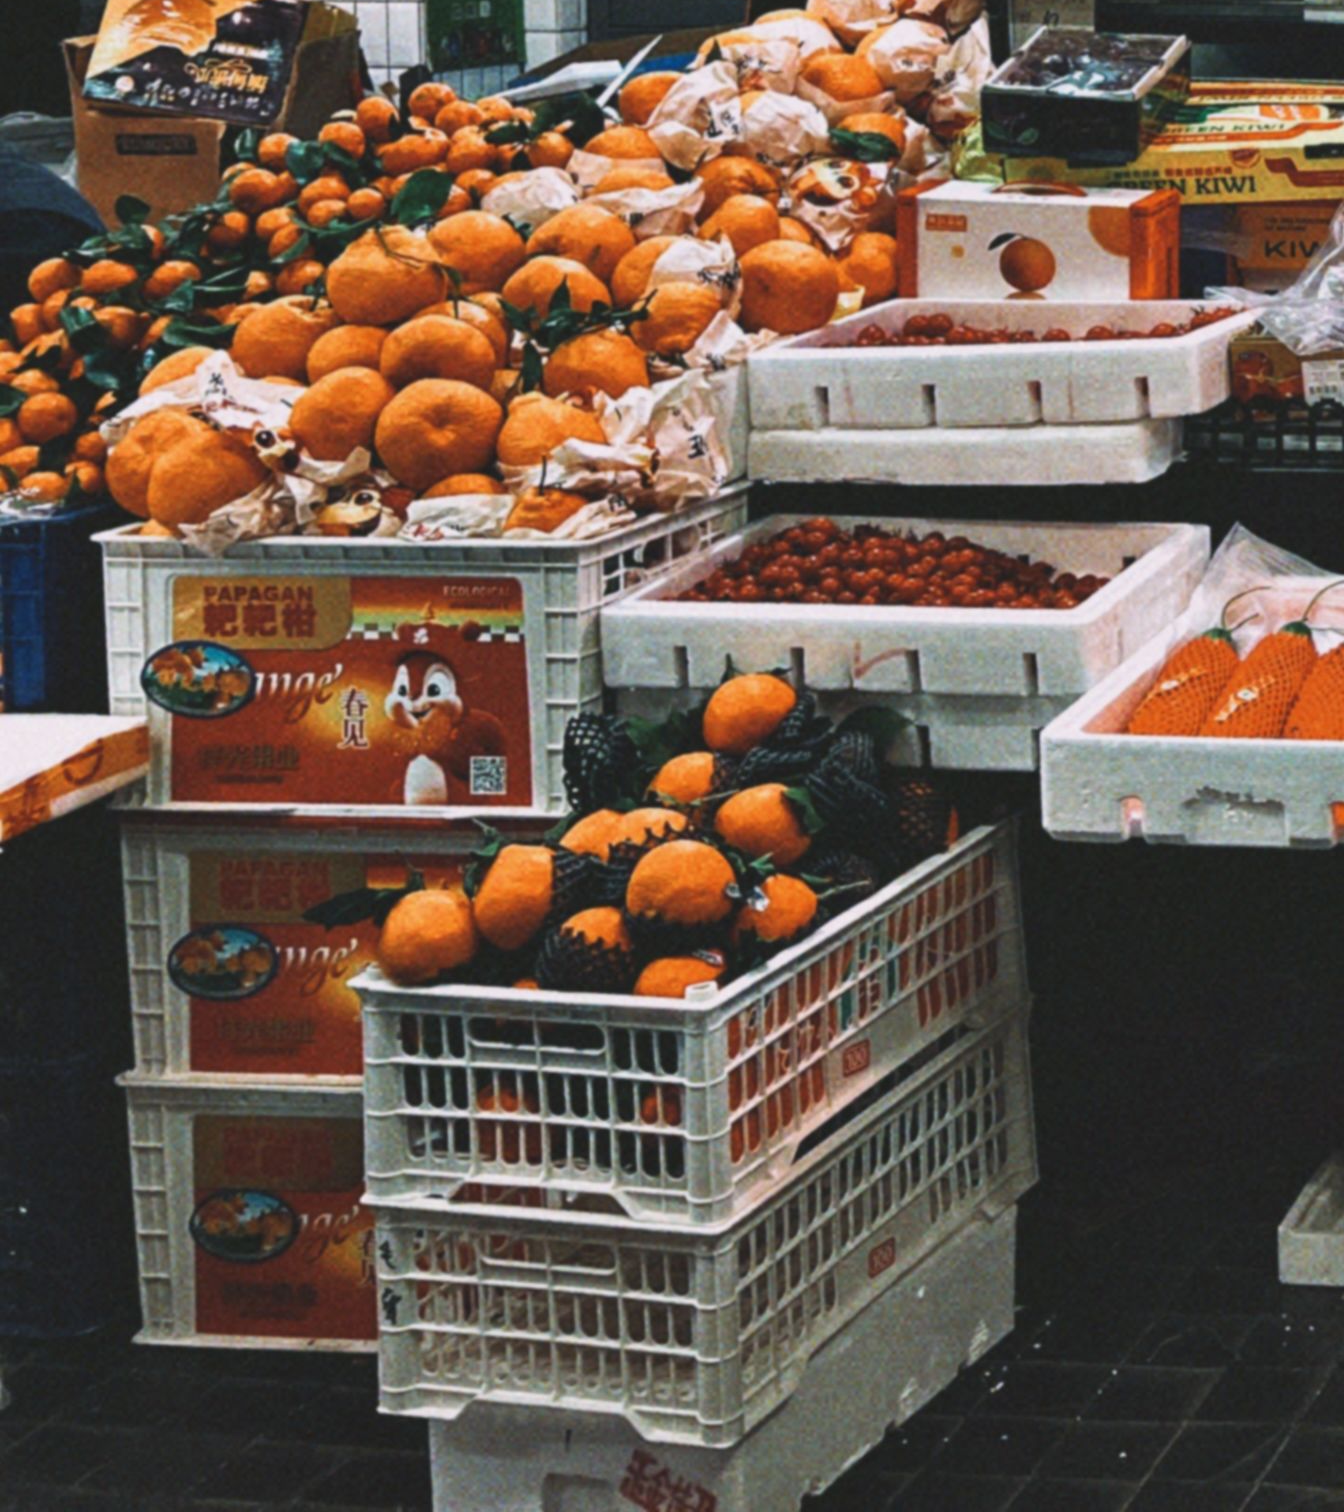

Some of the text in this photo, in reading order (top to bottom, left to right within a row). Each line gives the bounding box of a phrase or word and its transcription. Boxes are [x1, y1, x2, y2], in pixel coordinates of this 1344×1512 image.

[1195, 176, 1257, 196] KIWI
[203, 585, 314, 603] PAPAGAN
[339, 687, 370, 750] 春见
